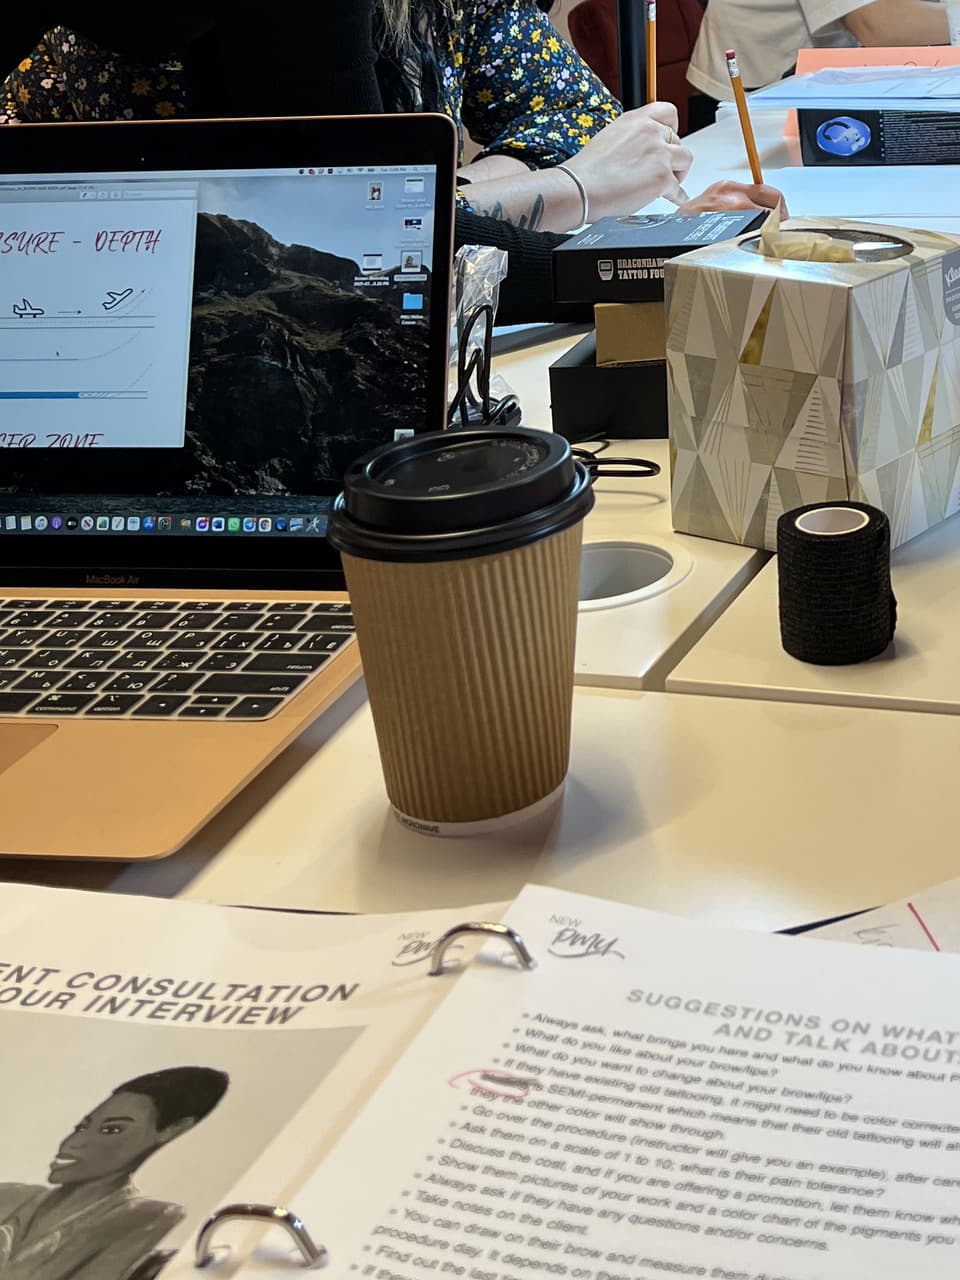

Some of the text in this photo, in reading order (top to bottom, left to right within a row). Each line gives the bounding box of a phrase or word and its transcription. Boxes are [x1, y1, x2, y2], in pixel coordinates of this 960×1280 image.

[0, 229, 162, 256] SURE DEPTH
[617, 258, 668, 269] DRAGONHAW
[617, 269, 648, 280] TATTOO
[85, 574, 139, 584] MacBook Air
[66, 970, 360, 1003] CONSULTATION
[83, 994, 305, 1026] INTERVIEW
[627, 988, 821, 1030] SUGGESTIONS
[831, 1018, 871, 1036] ON
[881, 1023, 960, 1047] WHAT
[524, 1026, 559, 1044] What
[607, 1043, 633, 1057] like
[635, 1049, 673, 1064] about
[675, 1056, 704, 1069] your
[532, 1012, 579, 1031] Always
[612, 1028, 644, 1043] what
[645, 1033, 687, 1051] brings
[718, 1044, 748, 1059] here
[781, 1055, 813, 1068] what
[866, 1063, 902, 1078] know
[905, 1069, 945, 1083] about
[713, 1022, 773, 1043] AND
[785, 1030, 853, 1053] TALK
[514, 1041, 549, 1059] What
[599, 1060, 633, 1074] want
[651, 1068, 702, 1086] change
[705, 1077, 743, 1092] about
[747, 1083, 776, 1097] your
[469, 1083, 499, 1103] they
[526, 1093, 563, 1113] other
[565, 1104, 601, 1120] color
[603, 1111, 625, 1125] will
[627, 1116, 666, 1131] show
[515, 1060, 545, 1079] they
[547, 1066, 581, 1081] have
[583, 1074, 635, 1094] existing
[741, 1099, 781, 1114] might
[783, 1105, 821, 1119] need
[863, 1114, 899, 1128] color
[495, 1111, 527, 1125] over
[553, 1122, 627, 1144] procedure
[704, 1147, 728, 1160] will
[730, 1151, 761, 1165] give
[893, 1171, 929, 1185] after
[665, 1105, 707, 1120] which
[709, 1111, 757, 1128] means
[760, 1117, 789, 1132] that
[791, 1121, 821, 1136] their
[918, 1137, 941, 1150] will
[489, 1127, 525, 1143] them
[562, 1143, 601, 1158] scale
[679, 1160, 714, 1177] what
[733, 1168, 765, 1184] their
[769, 1175, 801, 1189] pain
